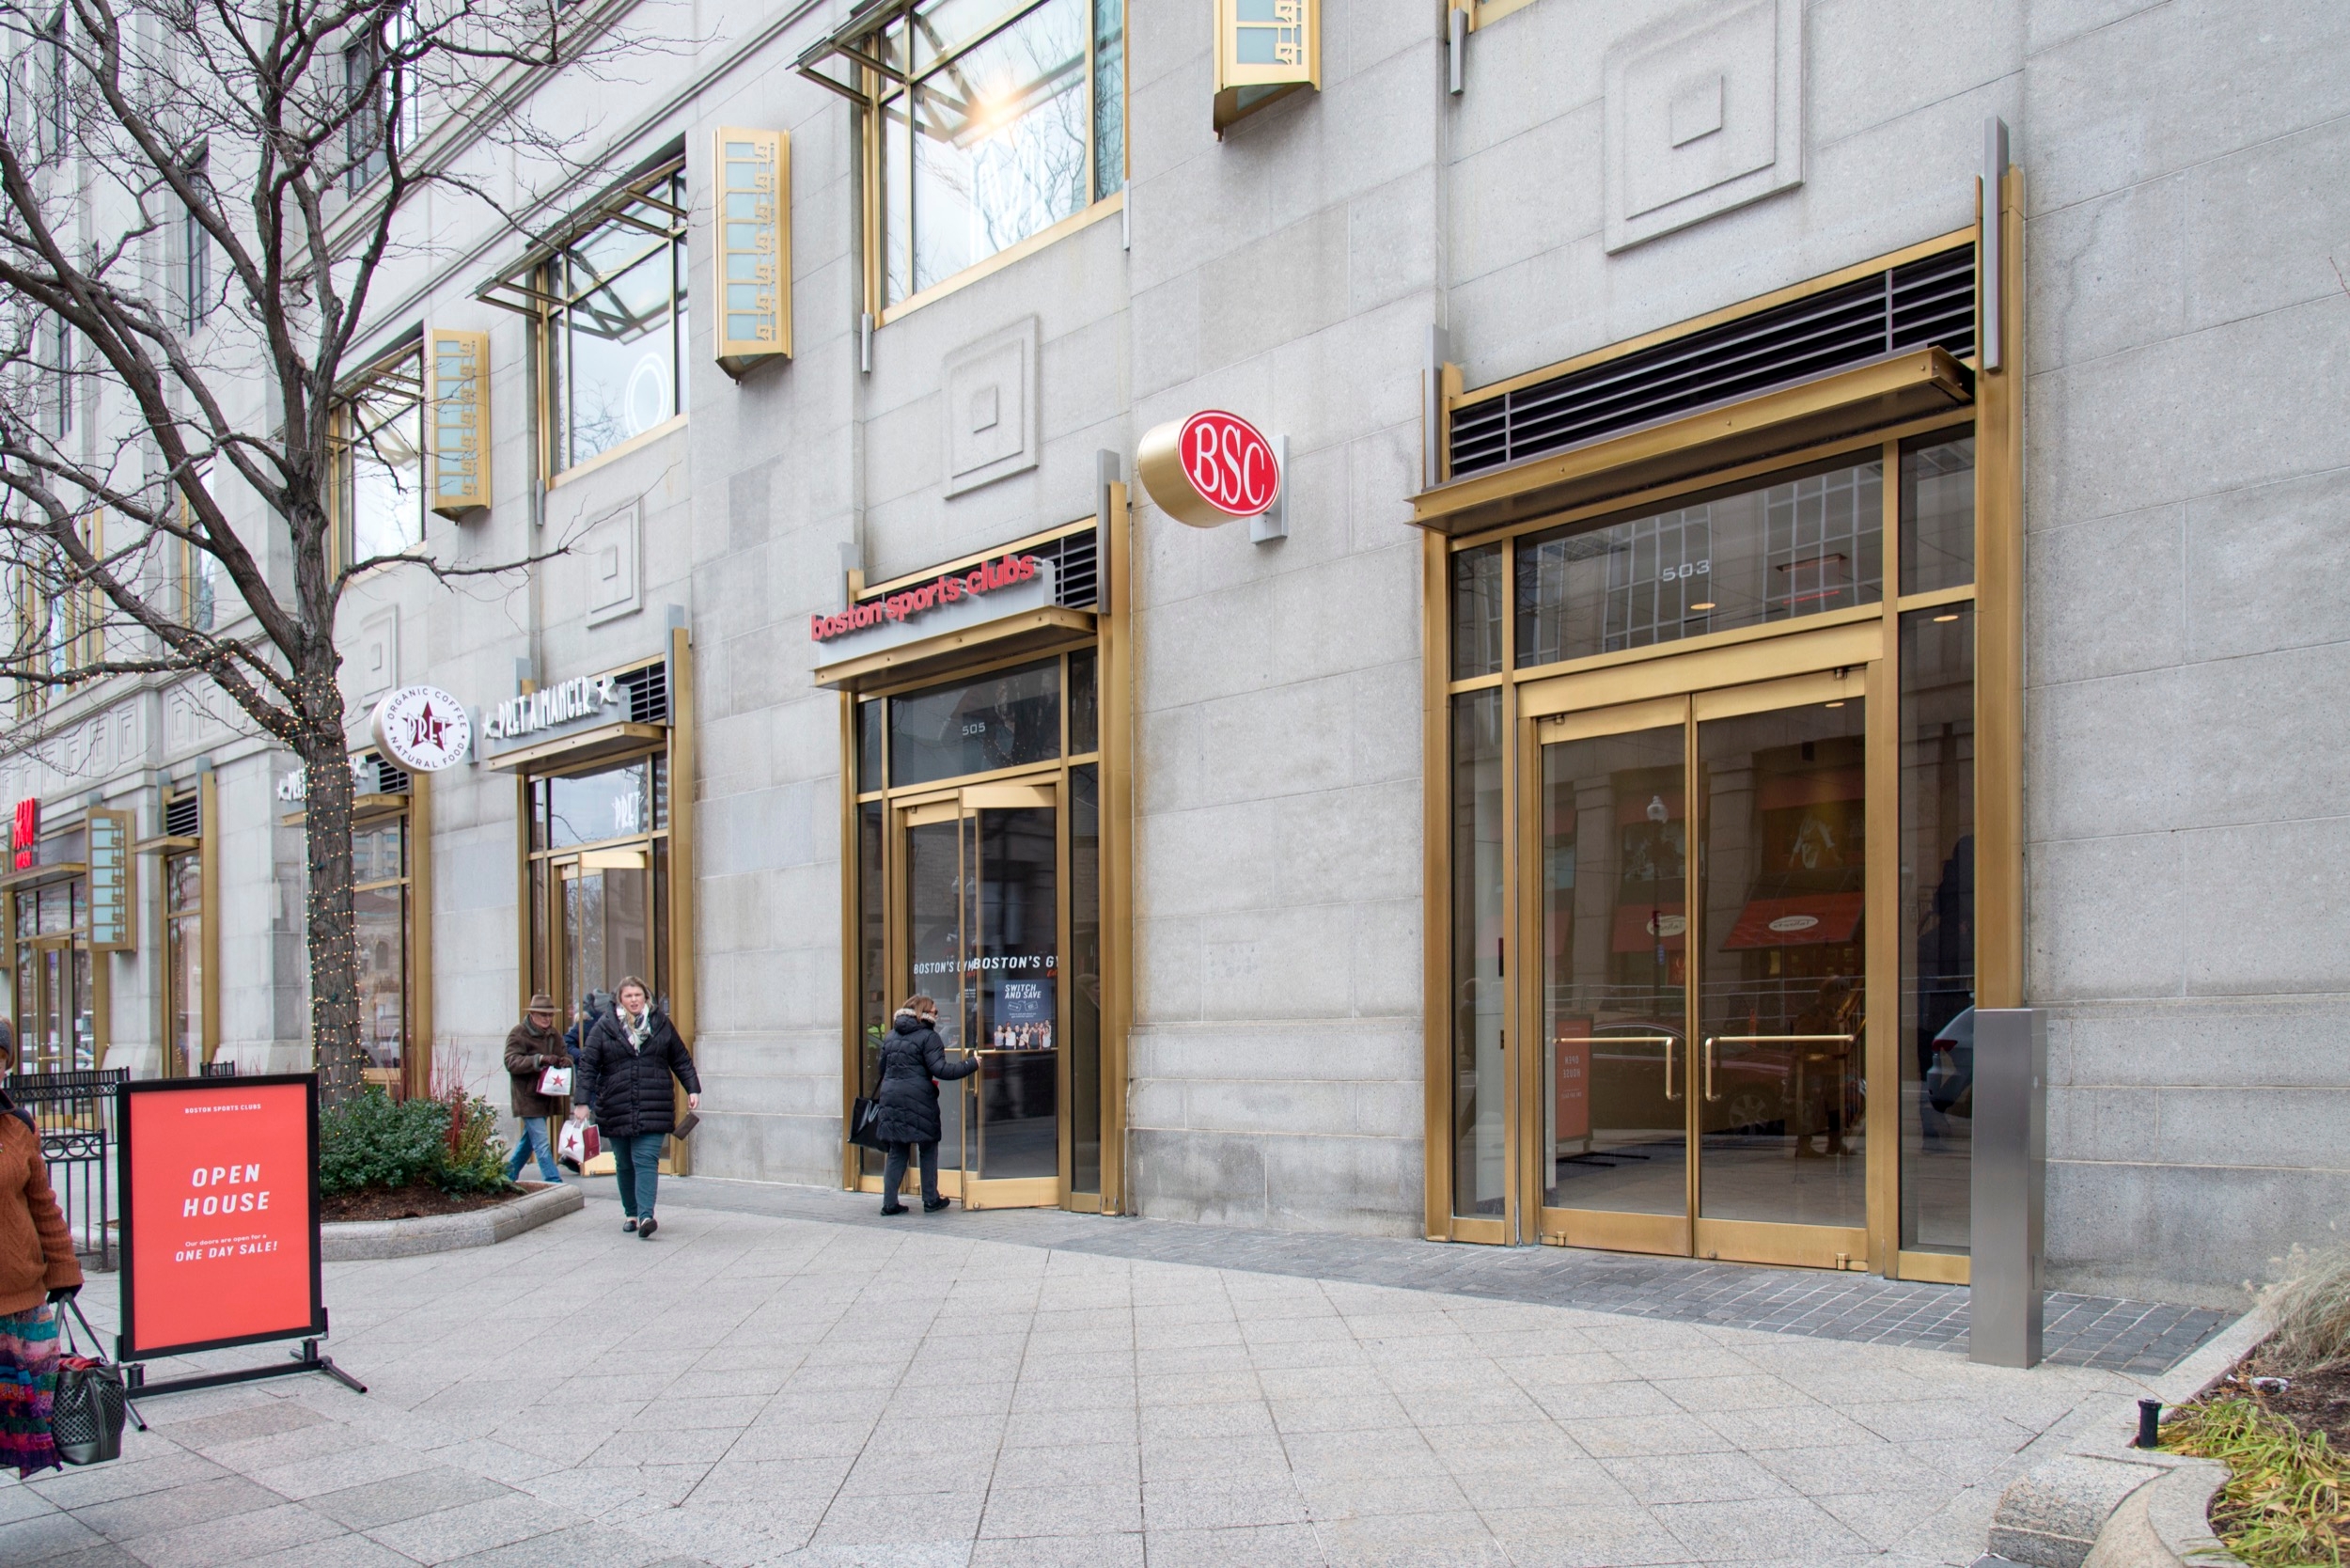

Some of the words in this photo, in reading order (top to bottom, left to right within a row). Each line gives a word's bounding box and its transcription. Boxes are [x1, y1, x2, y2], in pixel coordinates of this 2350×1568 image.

[1194, 422, 1264, 505] BSC
[1663, 559, 1710, 582] 503
[811, 604, 883, 641] boston
[885, 574, 961, 621] sports
[965, 554, 1035, 594] clubs
[387, 687, 429, 720] ORGANIC
[434, 691, 467, 728] COFFEE
[498, 696, 525, 738] PRET
[530, 692, 538, 730] A
[540, 676, 591, 730] MANGER
[407, 713, 449, 745] PRET
[963, 722, 985, 736] 505
[391, 736, 438, 768] NATURAL
[443, 743, 464, 765] FOOD
[614, 791, 641, 833] PRET
[914, 961, 954, 975] BOSTON'S
[973, 955, 1041, 970] BOSTON'S
[1005, 983, 1037, 993] SWITCH
[1005, 991, 1022, 999] AND
[1023, 990, 1042, 999] SAVE
[192, 1164, 260, 1187] OPEN
[183, 1191, 270, 1217] HOUSE
[175, 1249, 202, 1262] ONE
[209, 1246, 234, 1258] DAY
[239, 1240, 277, 1255] SALE!
